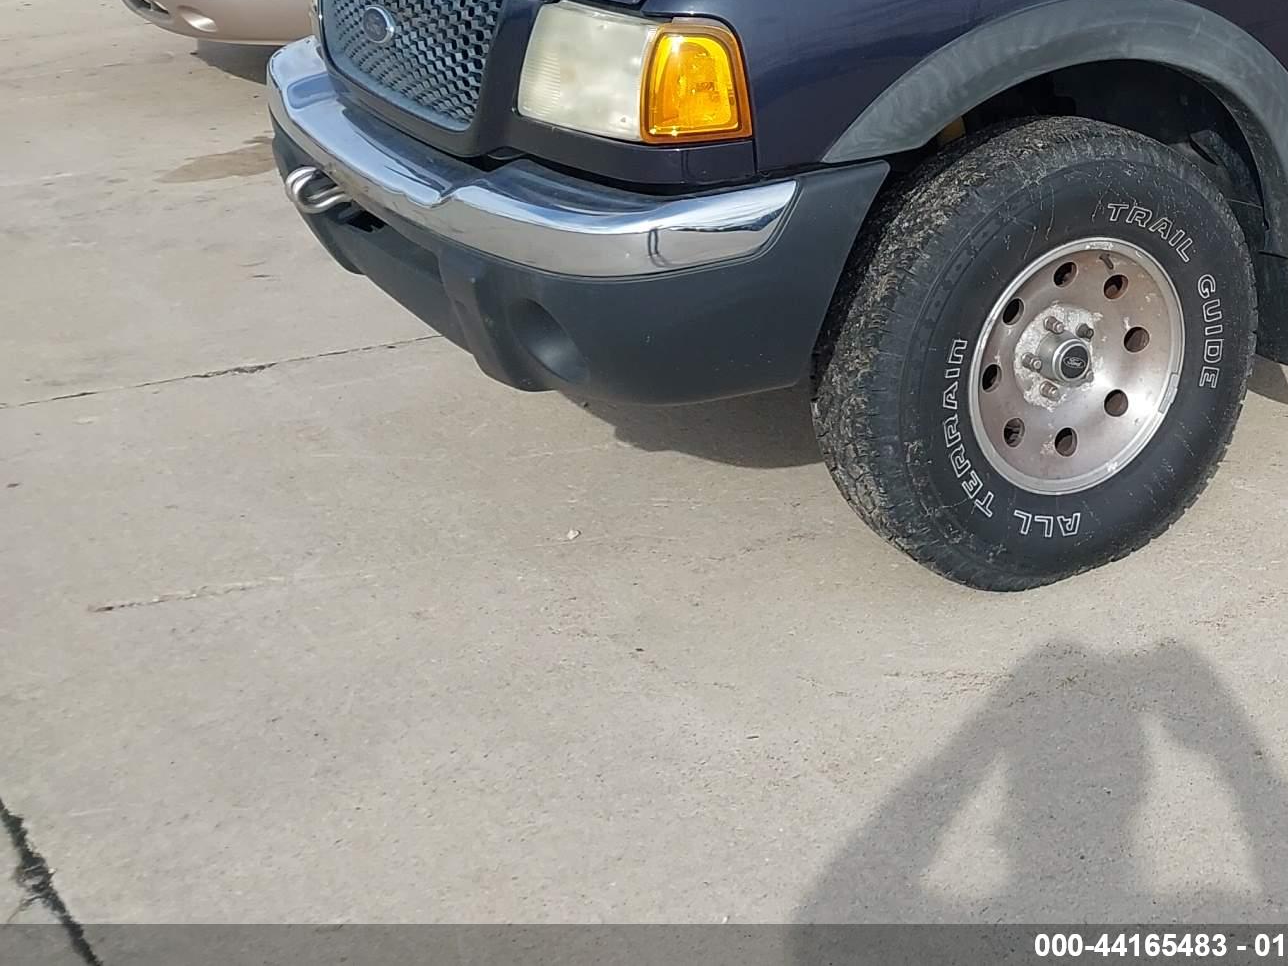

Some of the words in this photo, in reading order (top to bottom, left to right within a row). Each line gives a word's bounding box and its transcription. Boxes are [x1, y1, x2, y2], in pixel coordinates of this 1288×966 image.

[1107, 202, 1195, 264] TRAIL
[1197, 274, 1223, 389] GUIDE
[943, 338, 995, 518] TERRAIN
[1014, 509, 1081, 538] ALL
